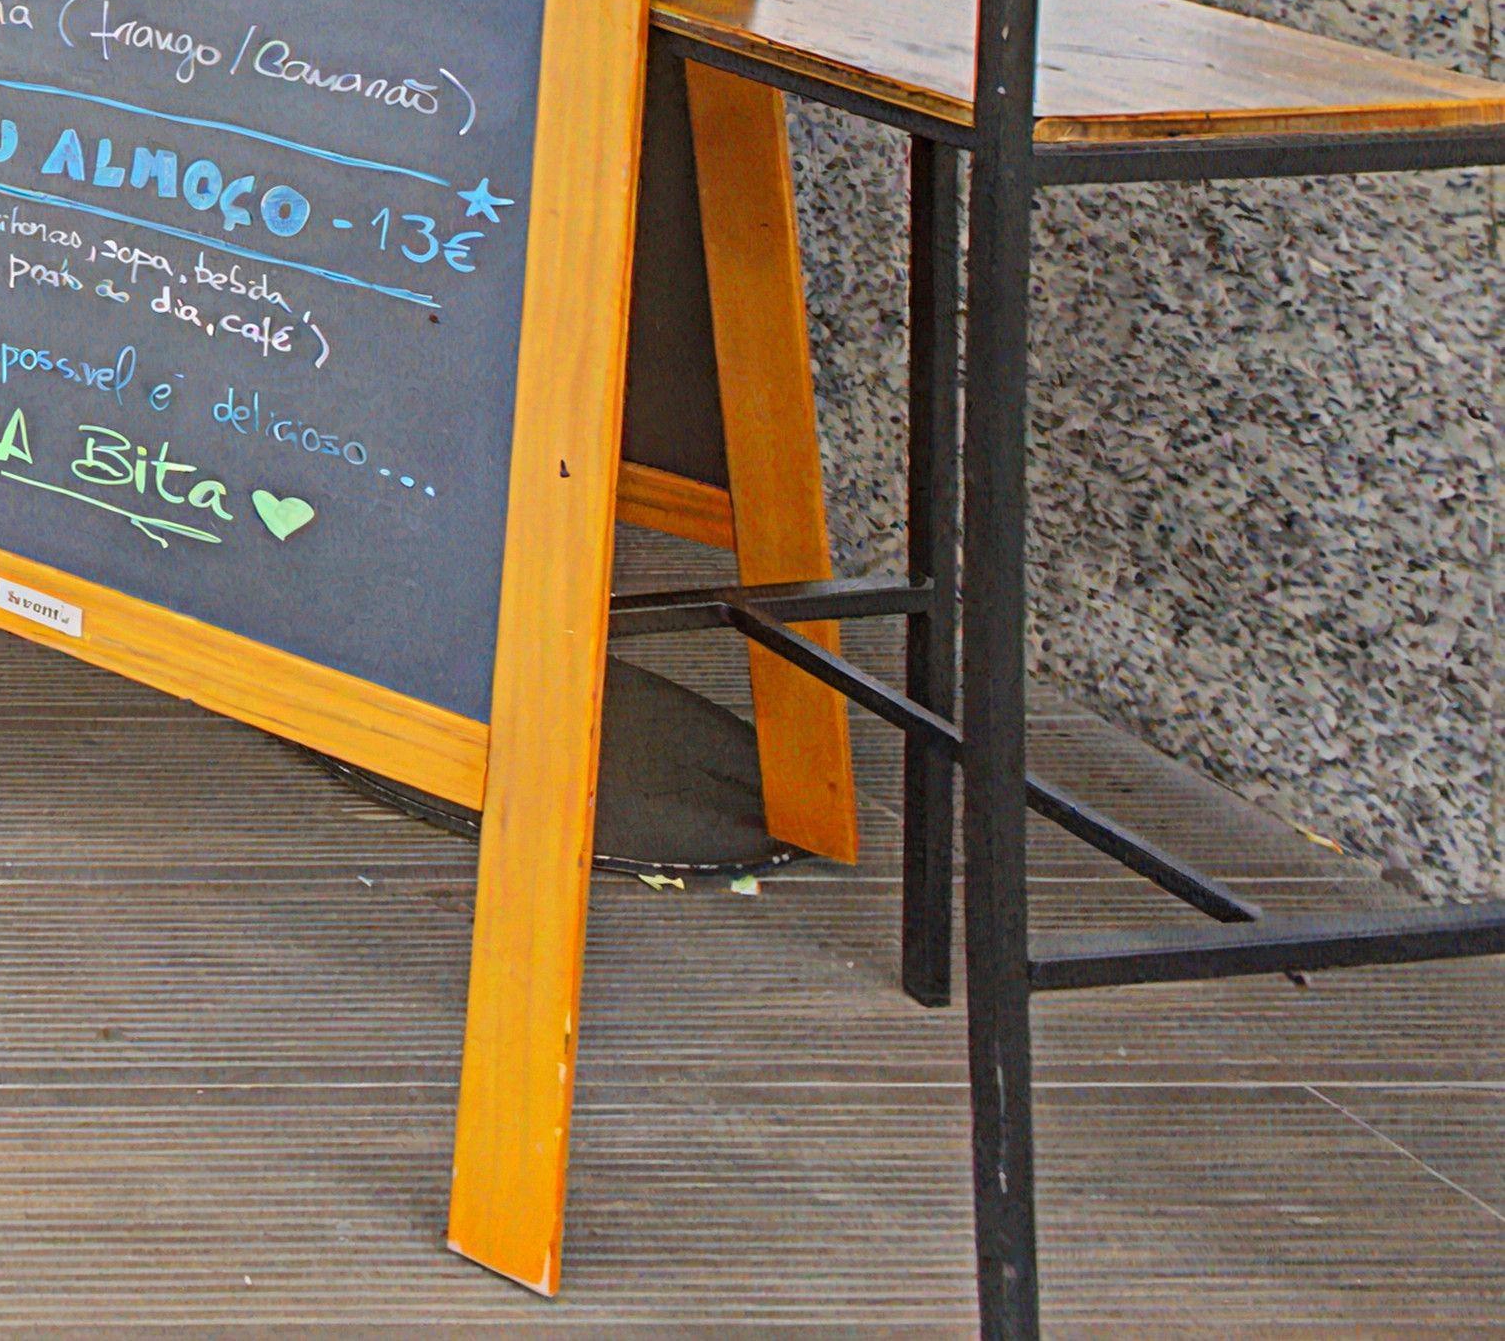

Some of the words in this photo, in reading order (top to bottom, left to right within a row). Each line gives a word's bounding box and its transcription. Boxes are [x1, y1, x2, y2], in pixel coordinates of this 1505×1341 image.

[39, 127, 311, 238] ALMOÇO
[370, 207, 485, 273] 13€
[70, 423, 234, 521] Bita
